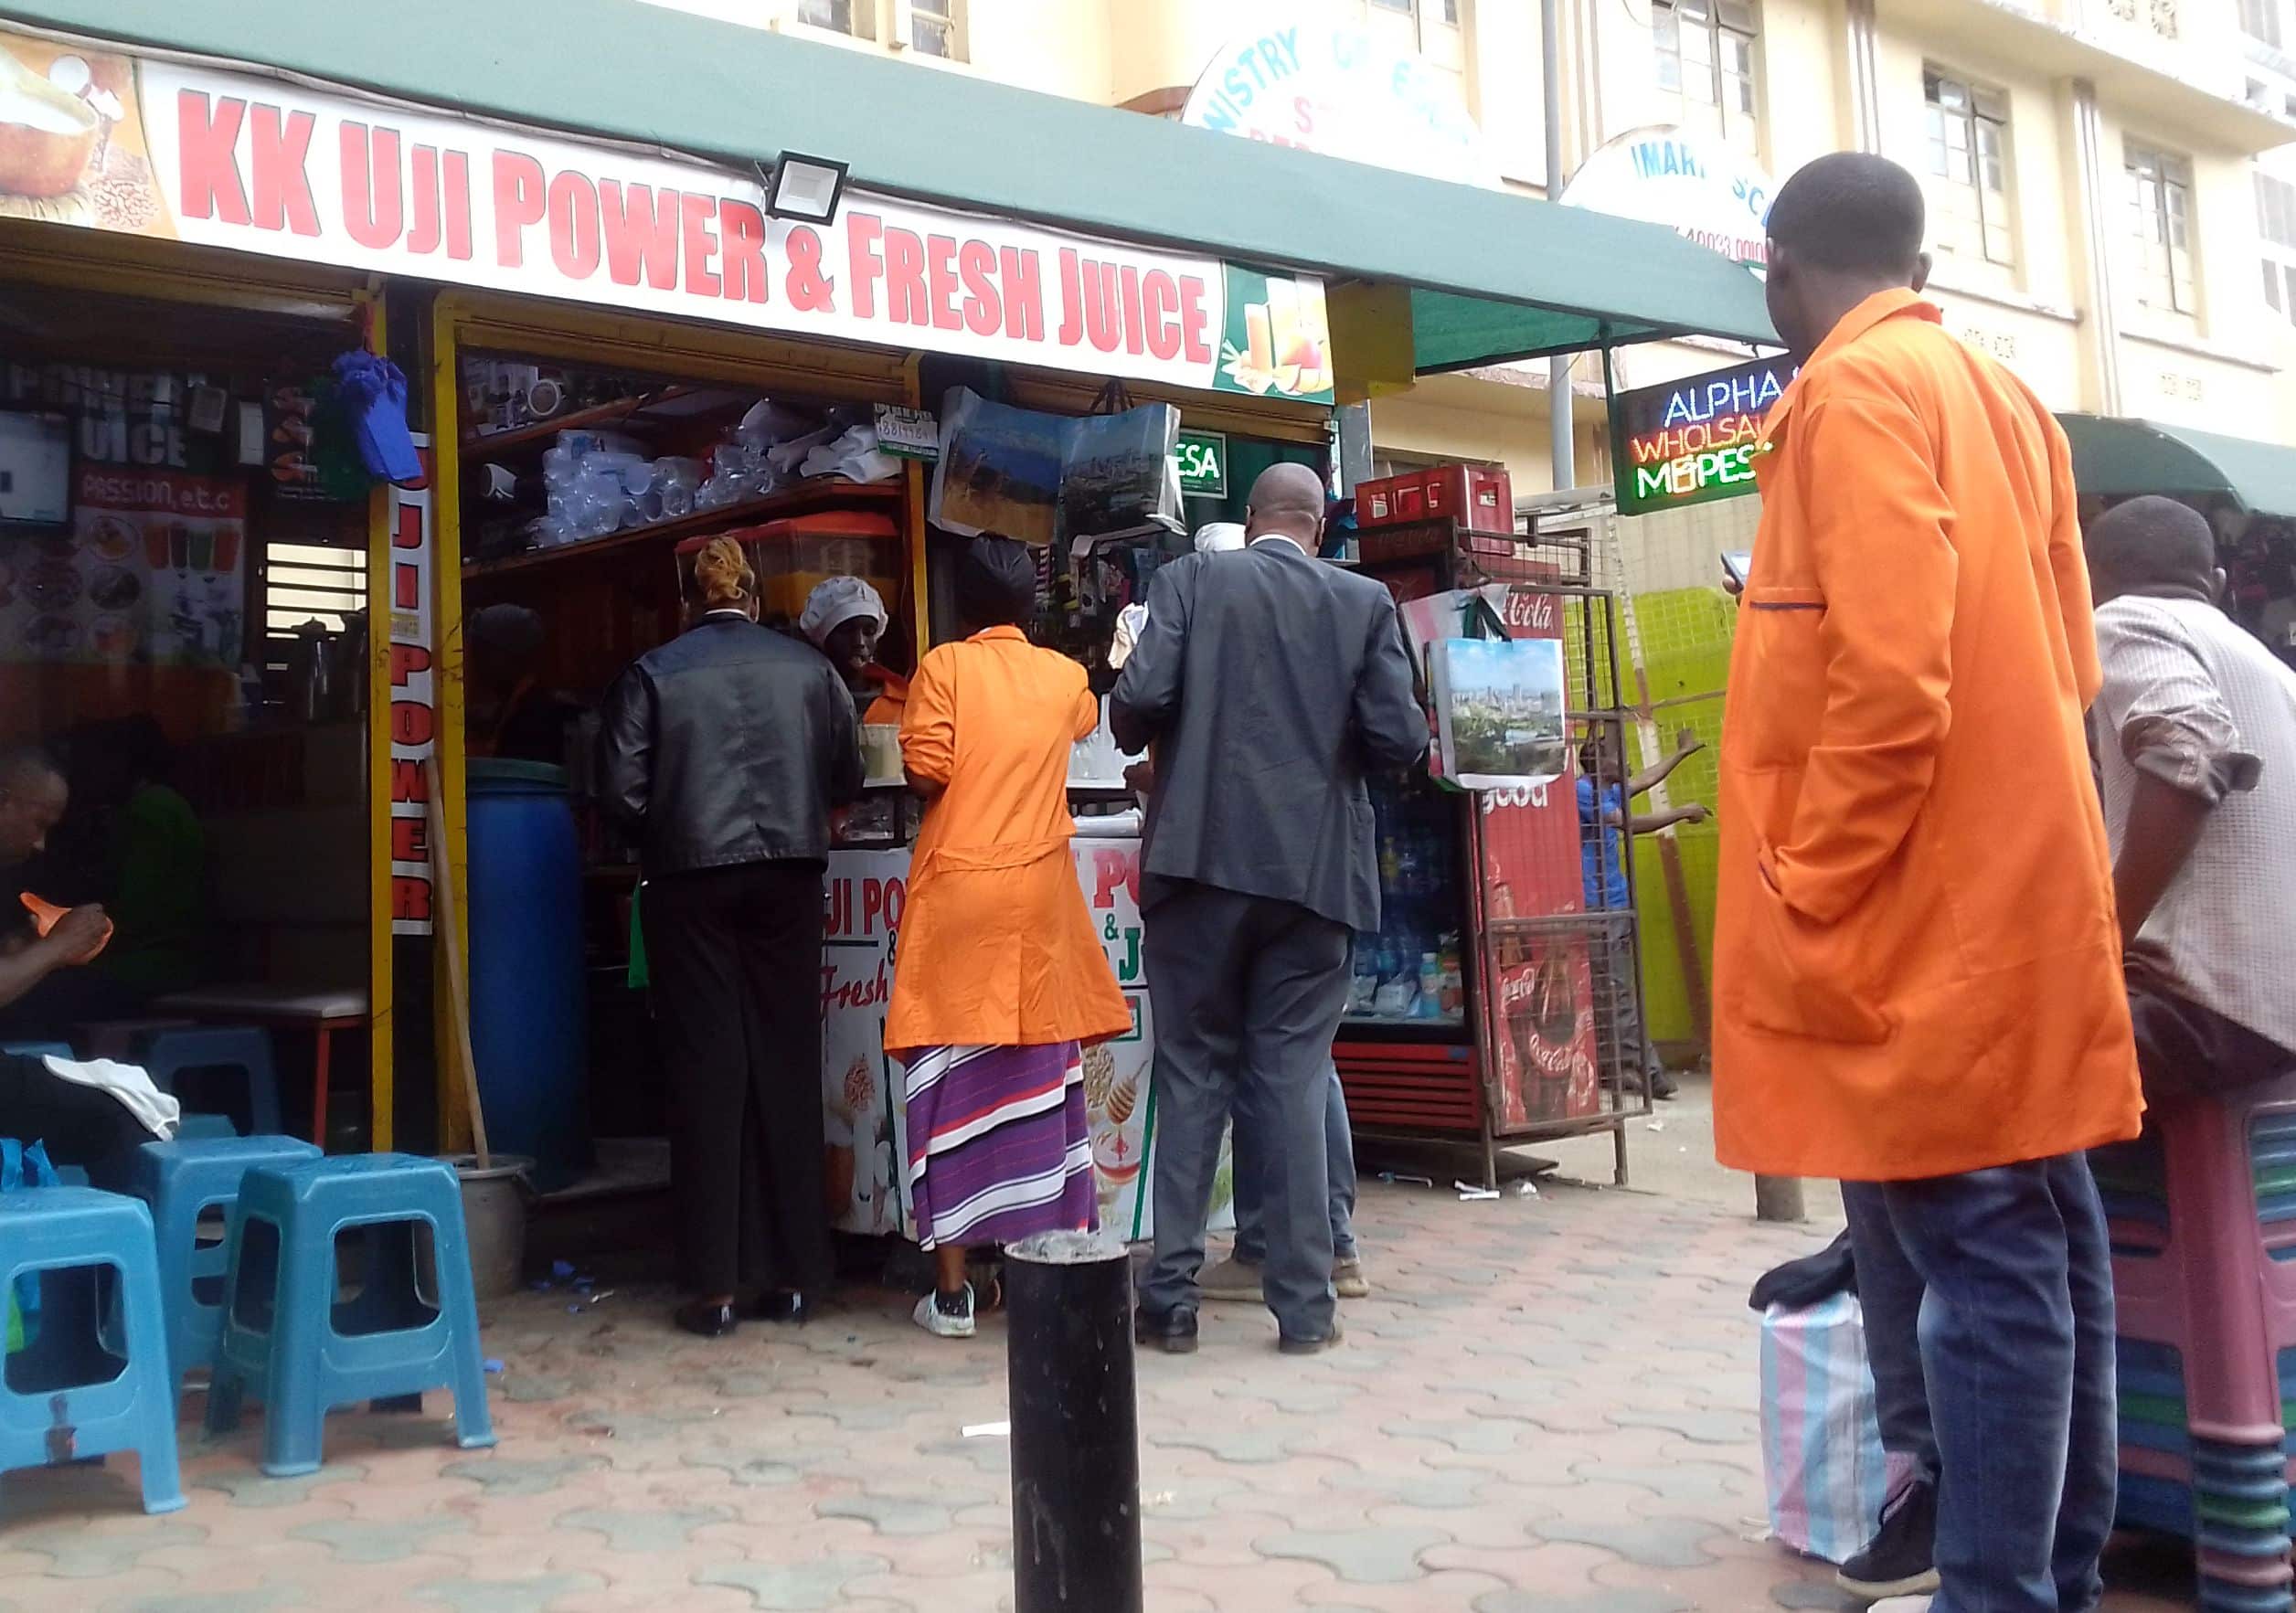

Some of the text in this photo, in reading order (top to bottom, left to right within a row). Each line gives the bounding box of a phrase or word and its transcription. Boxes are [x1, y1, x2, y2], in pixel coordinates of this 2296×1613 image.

[178, 88, 1211, 363] KK UJI POWER & FRESH JUICE
[1664, 368, 1784, 428] ALPHA
[81, 413, 186, 468] UICE
[1502, 582, 1553, 631] Cola
[390, 642, 431, 920] POWER
[821, 877, 910, 935] JI PO
[1104, 913, 1119, 940] &
[1119, 928, 1143, 981] J
